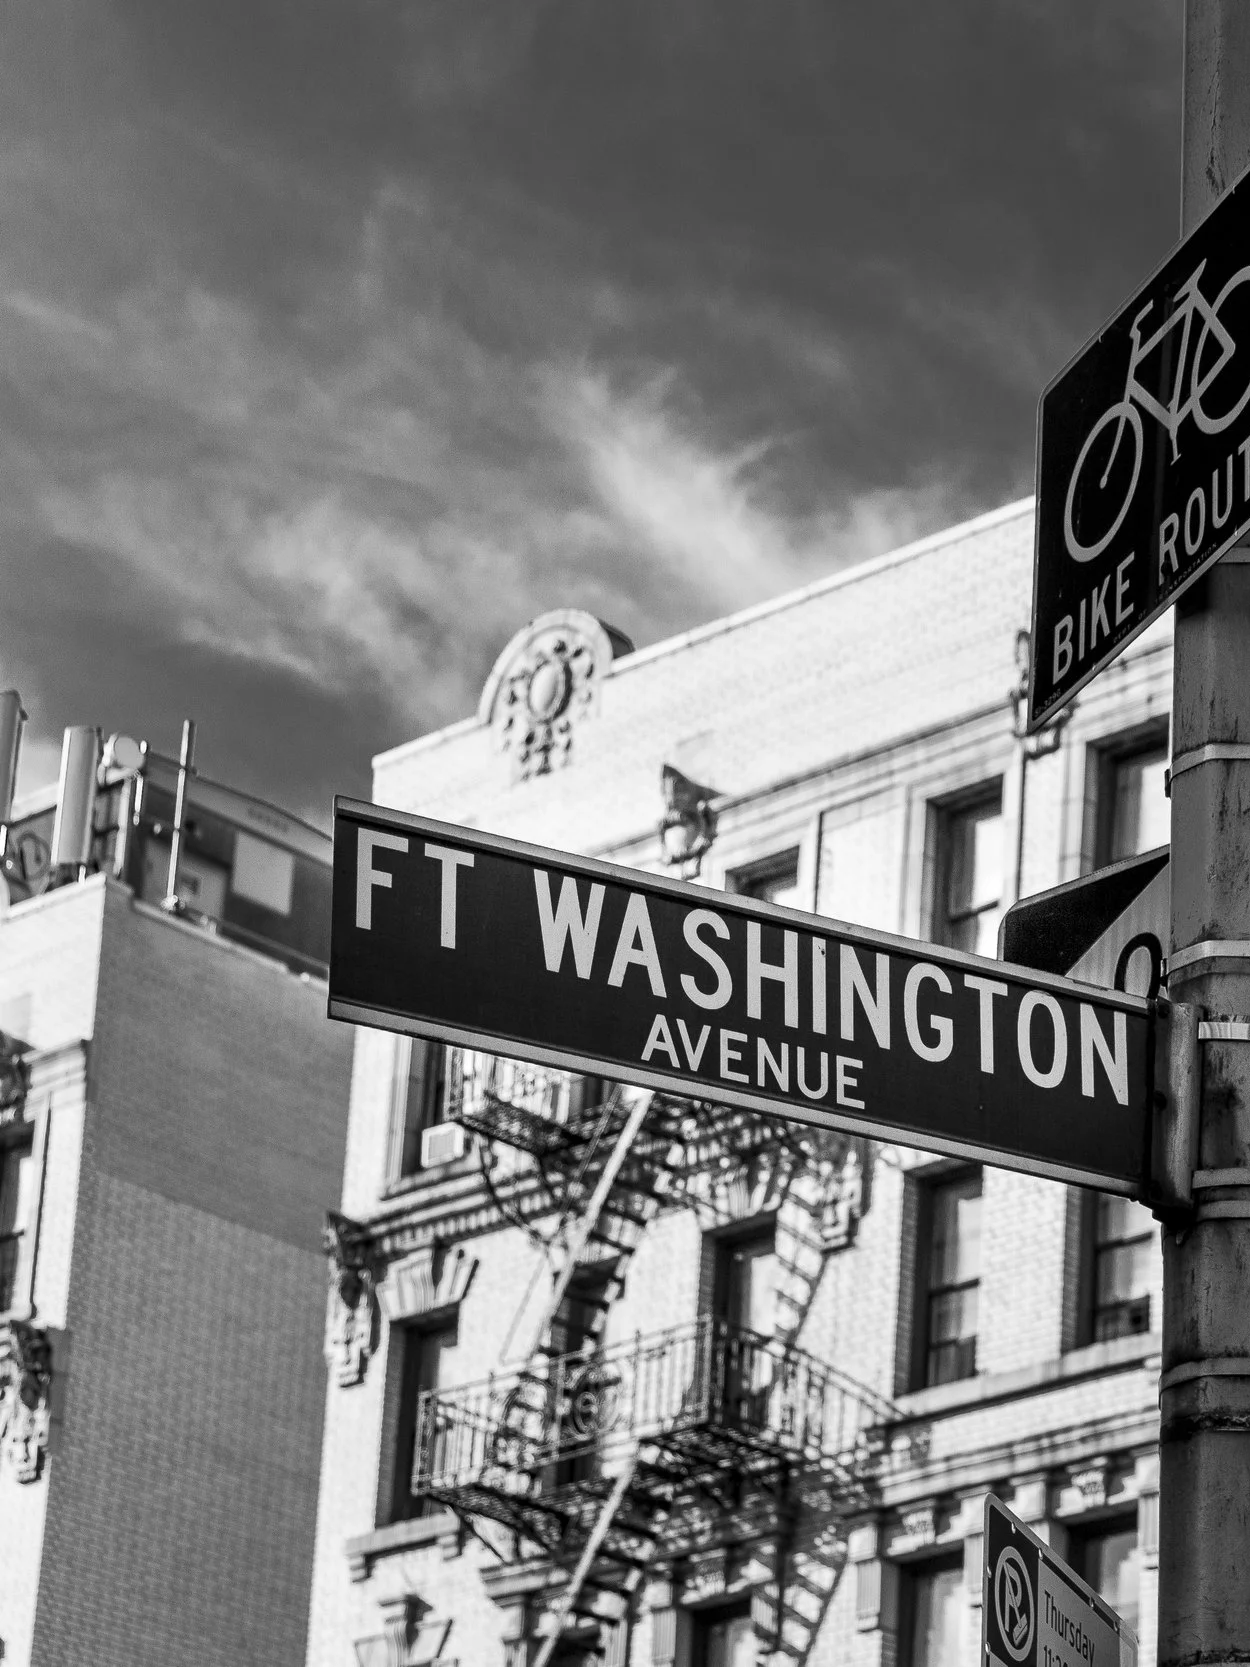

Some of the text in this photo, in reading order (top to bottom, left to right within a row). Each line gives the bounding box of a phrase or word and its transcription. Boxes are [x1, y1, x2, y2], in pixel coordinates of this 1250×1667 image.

[1052, 551, 1135, 685] BIKE
[355, 827, 1129, 1106] FT WASHINGTON
[640, 1013, 866, 1110] AVENUE
[1043, 1645, 1069, 1667] 11:
[1044, 1589, 1095, 1667] Thursday
